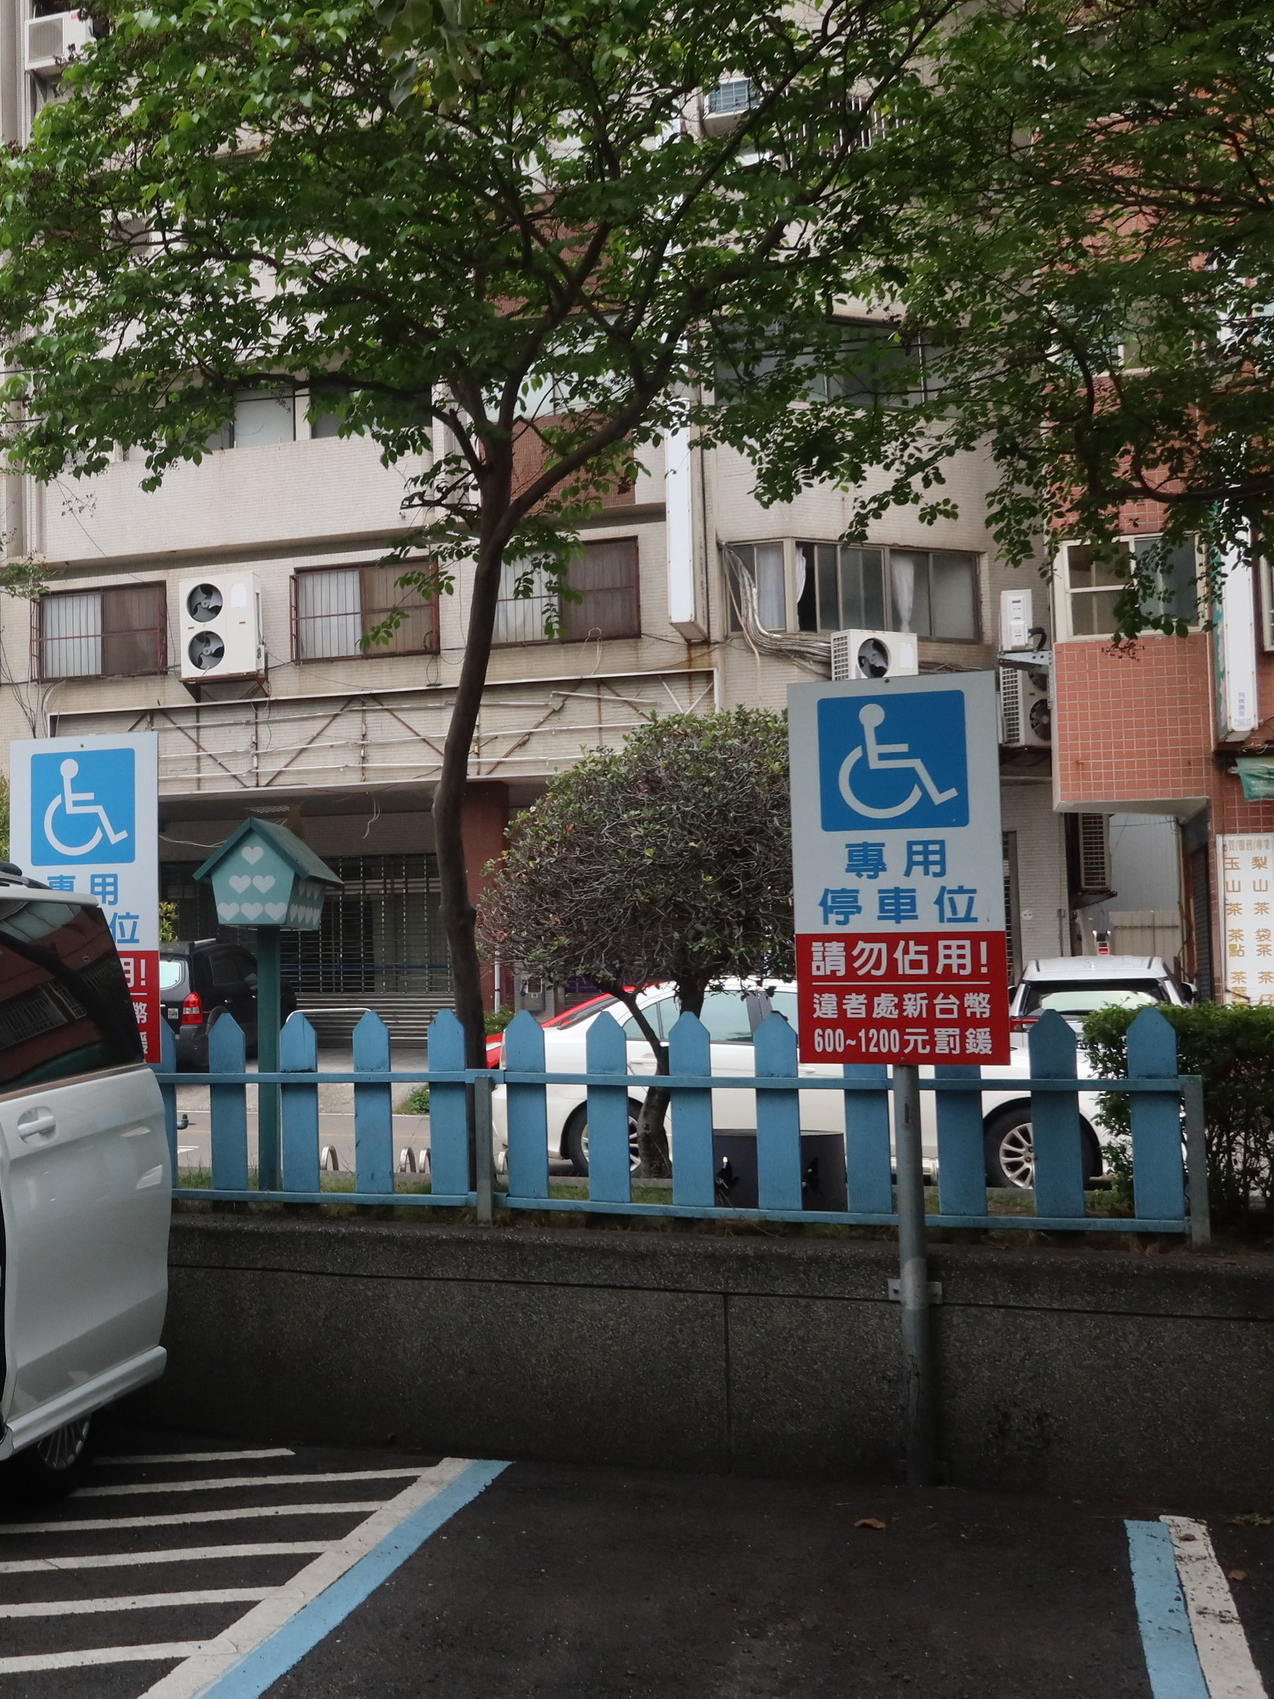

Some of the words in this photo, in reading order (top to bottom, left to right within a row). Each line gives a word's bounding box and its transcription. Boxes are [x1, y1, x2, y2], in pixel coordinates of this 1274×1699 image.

[845, 839, 947, 879] 專用
[818, 885, 978, 926] 停車位
[811, 940, 988, 976] 請勿佔用!
[1228, 928, 1245, 957] 茶點
[813, 992, 991, 1019] 違者處新台幣
[814, 1027, 993, 1055] 600~1200元罰鍰
